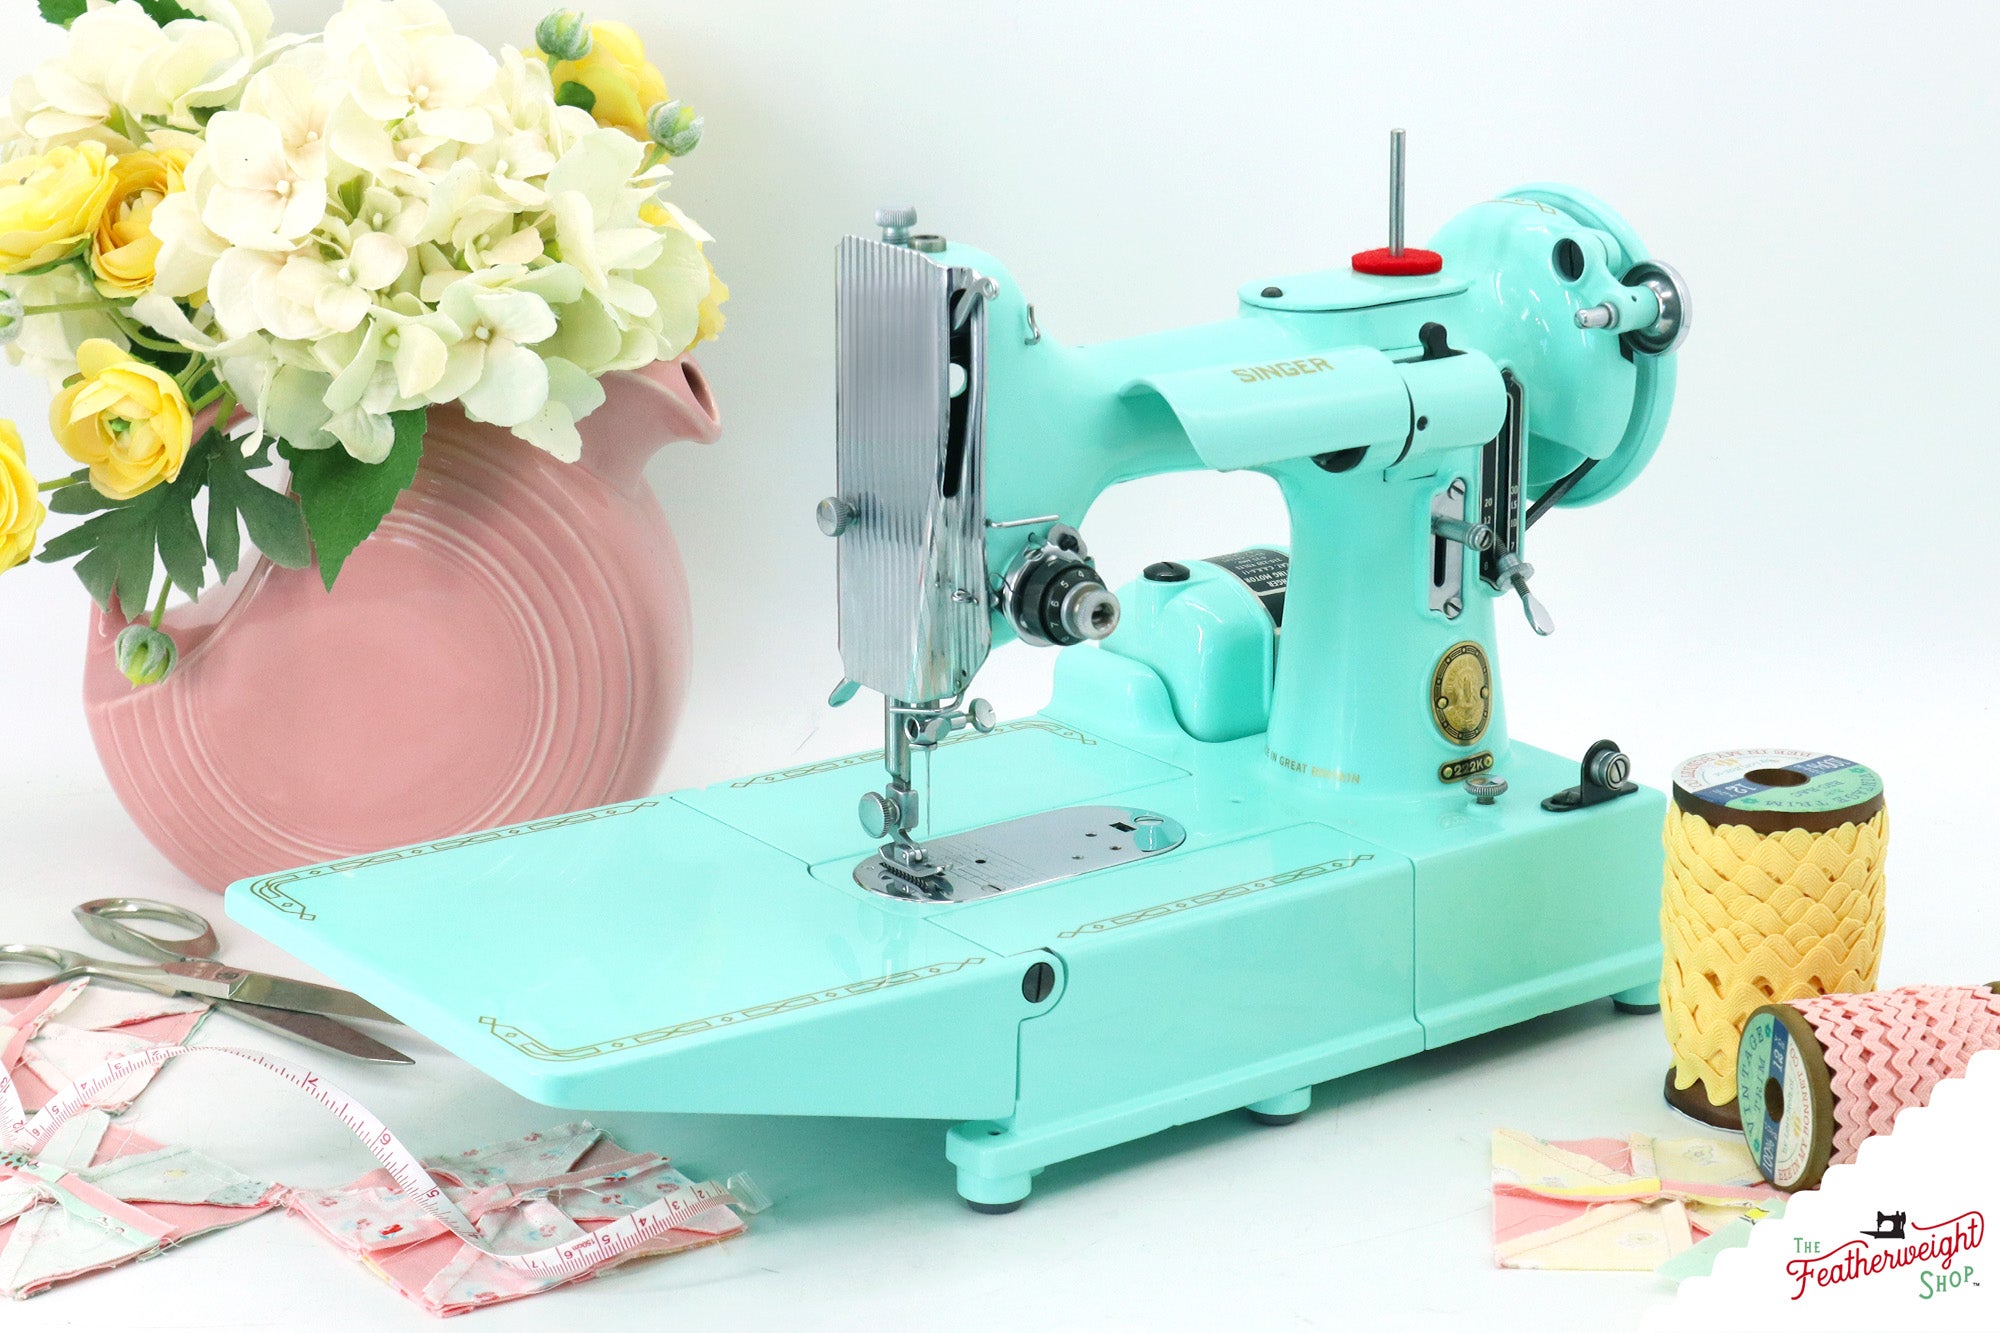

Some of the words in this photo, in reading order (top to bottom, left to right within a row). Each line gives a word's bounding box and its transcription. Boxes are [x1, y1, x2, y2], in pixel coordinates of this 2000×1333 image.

[1231, 358, 1334, 382] SINGER
[1484, 498, 1493, 508] 20
[1245, 574, 1272, 583] MOTOR
[1273, 570, 1288, 579] ING
[1060, 580, 1069, 588] 5
[1266, 579, 1287, 588] NGER
[1270, 751, 1277, 763] IN
[1279, 757, 1307, 774] GREAT
[1311, 766, 1360, 784] BRITAIN
[1453, 758, 1484, 777] 222K
[1725, 783, 1757, 794] 12
[1832, 773, 1877, 804] VINTAGE
[1766, 800, 1828, 808] TRIM
[80, 1082, 88, 1090] 4
[308, 1077, 320, 1088] 7
[1741, 1026, 1764, 1137] VINTAGE
[1753, 1056, 1766, 1112] TRIM
[1798, 1070, 1810, 1137] BONNET
[52, 1105, 60, 1115] 5
[32, 1128, 41, 1137] 6
[1798, 1141, 1808, 1162] MY
[1763, 1139, 1775, 1175] 100%
[426, 1189, 440, 1198] 5
[698, 1190, 706, 1198] 2
[671, 1200, 680, 1210] 3
[638, 1217, 648, 1227] 4
[571, 1237, 597, 1251] 150cm
[601, 1234, 611, 1245] 5
[564, 1250, 573, 1259] 6
[531, 1260, 539, 1269] 7
